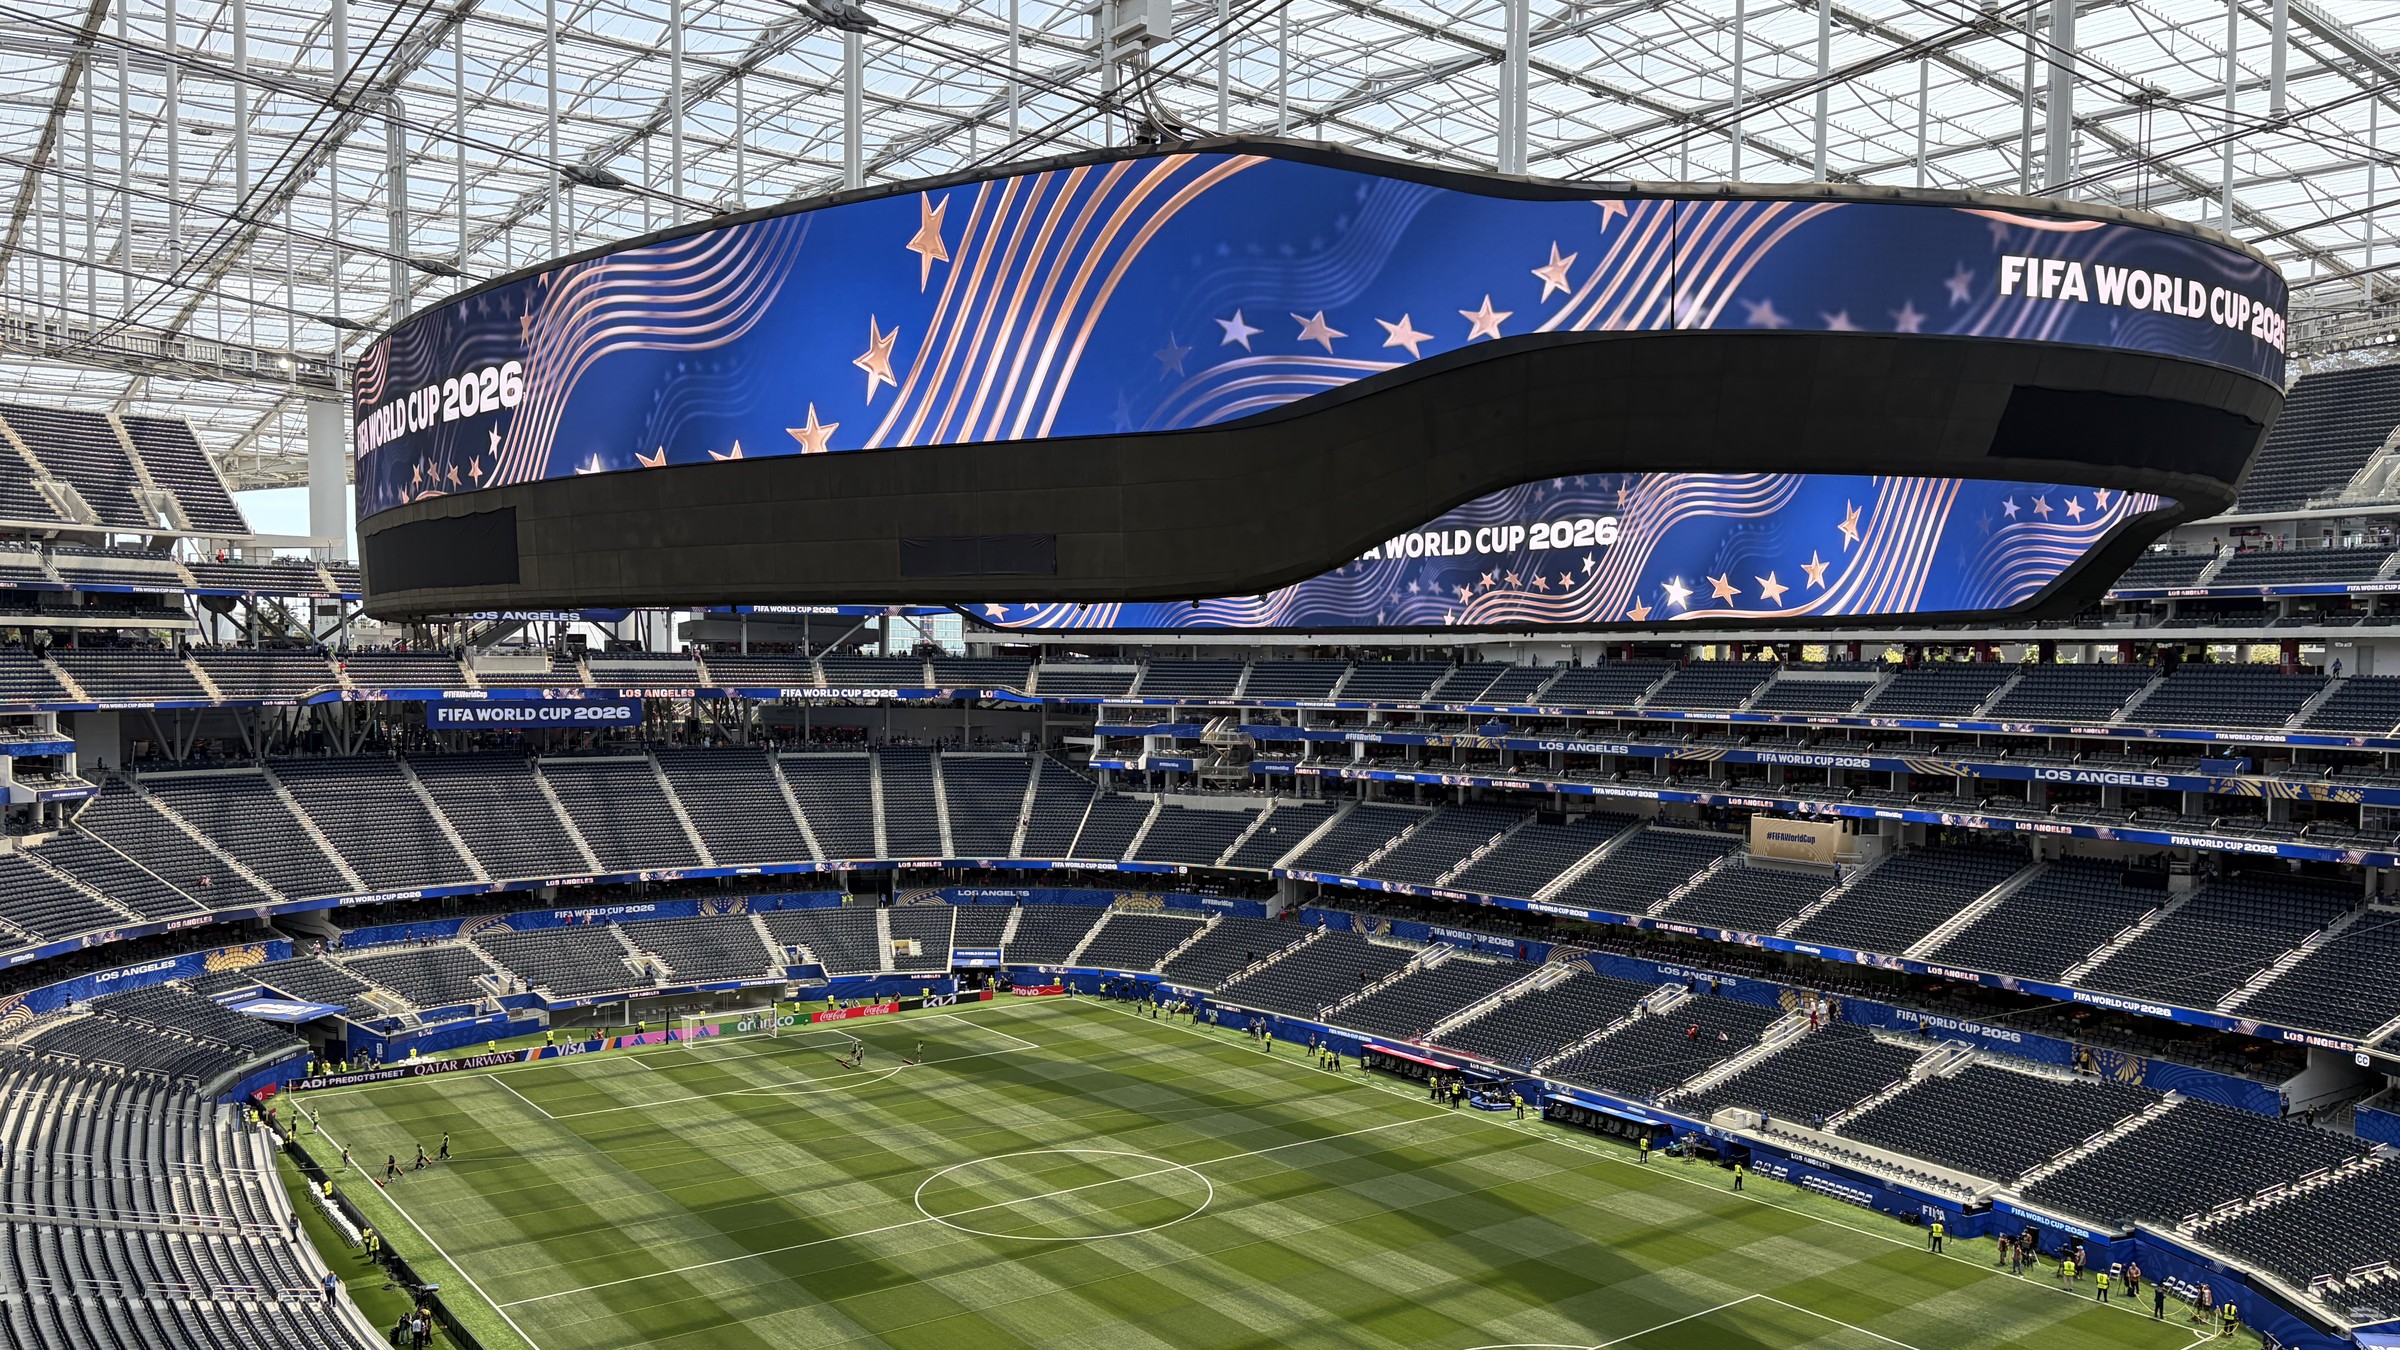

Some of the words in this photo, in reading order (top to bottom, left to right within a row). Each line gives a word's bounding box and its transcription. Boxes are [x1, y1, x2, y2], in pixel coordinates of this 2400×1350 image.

[2000, 255, 2088, 302] FIFA
[2094, 264, 2206, 319] WORLD
[2210, 286, 2250, 331] CUP
[2251, 301, 2286, 354] 2026
[357, 418, 369, 460] FIFA
[368, 398, 406, 450] WORLD
[408, 384, 440, 433] CUP
[443, 361, 524, 422] 2026
[1385, 529, 1471, 559] WORLD
[1475, 525, 1525, 552] CUP
[1529, 516, 1618, 550] 2026
[502, 611, 580, 621] ANGELES
[443, 690, 487, 699] #FIFAWorldCup
[620, 689, 641, 698] LOS
[644, 689, 695, 698] ANGELES
[781, 689, 800, 698] FIFA
[803, 689, 838, 698] WORLD
[841, 689, 860, 698] CUP
[862, 689, 897, 698] 2026
[438, 708, 474, 722] FIFA
[476, 708, 534, 722] WORLD
[539, 707, 570, 720] CUP
[574, 706, 631, 720] 2026
[1345, 733, 1382, 743] #FIFAWorldCup
[1539, 742, 1564, 751] LOS
[1568, 743, 1628, 754] ANGELES
[1757, 753, 1776, 762] FIFA
[1779, 754, 1813, 764] WORLD
[1816, 756, 1834, 766] CUP
[1836, 756, 1870, 768] 2026
[2034, 769, 2072, 781] LOS
[2079, 772, 2169, 788] ANGELES
[1639, 790, 1658, 798] 2026
[1743, 799, 1773, 808] ANGELES
[2016, 822, 2031, 831] LOS
[2034, 824, 2072, 834] ANGELES
[1766, 832, 1815, 845] #FIFAWorldCup
[2171, 836, 2189, 846] FIFA
[2191, 838, 2224, 849] WORLD
[2226, 841, 2243, 851] CUP
[2246, 842, 2277, 853] 2026
[355, 895, 380, 903] WORLD
[397, 891, 421, 900] 2026
[555, 910, 573, 918] FIFA
[574, 908, 604, 917] WORLD
[606, 906, 623, 915] CUP
[625, 904, 655, 914] 2026
[1539, 905, 1557, 913] WORLD
[1570, 908, 1588, 917] 2026
[167, 920, 180, 929] LOS
[182, 916, 212, 927] ANGELES
[1656, 922, 1668, 930] LOS
[1669, 924, 1698, 934] ANGELES
[1446, 929, 1472, 940] WORLD
[1489, 935, 1514, 947] 2026
[96, 970, 119, 982] LOS
[122, 960, 176, 978] ANGELES
[1658, 966, 1680, 977] LOS
[1927, 966, 1942, 976] LOS
[1944, 969, 1979, 982] ANGELES
[1012, 987, 1039, 996] enovo
[864, 1004, 890, 1016] Coca-Cola
[2074, 992, 2090, 1003] FIFA
[2092, 995, 2122, 1008] WORLD
[2124, 1000, 2140, 1011] CUP
[2142, 1003, 2172, 1016] 2026
[820, 1008, 846, 1022] Coca-Cola
[1896, 1010, 1917, 1022] FIFA
[1920, 1014, 1958, 1030] WORLD
[1961, 1022, 1981, 1035] CUP
[1984, 1026, 2021, 1042] 2026
[2284, 1031, 2303, 1043] LOS
[2307, 1035, 2354, 1052] ANGELES
[556, 1042, 586, 1056] VISA
[414, 1061, 457, 1076] QATAR
[463, 1052, 515, 1069] AIRWAYS
[2357, 1056, 2368, 1064] CC
[300, 1080, 326, 1089] ADI
[329, 1070, 404, 1085] PREDICTSTREET
[1791, 1152, 1802, 1162] LOS
[2011, 1207, 2024, 1219] FIFA
[2026, 1212, 2050, 1226] WORLD
[2051, 1219, 2064, 1230] CUP
[2066, 1223, 2089, 1238] 2026
